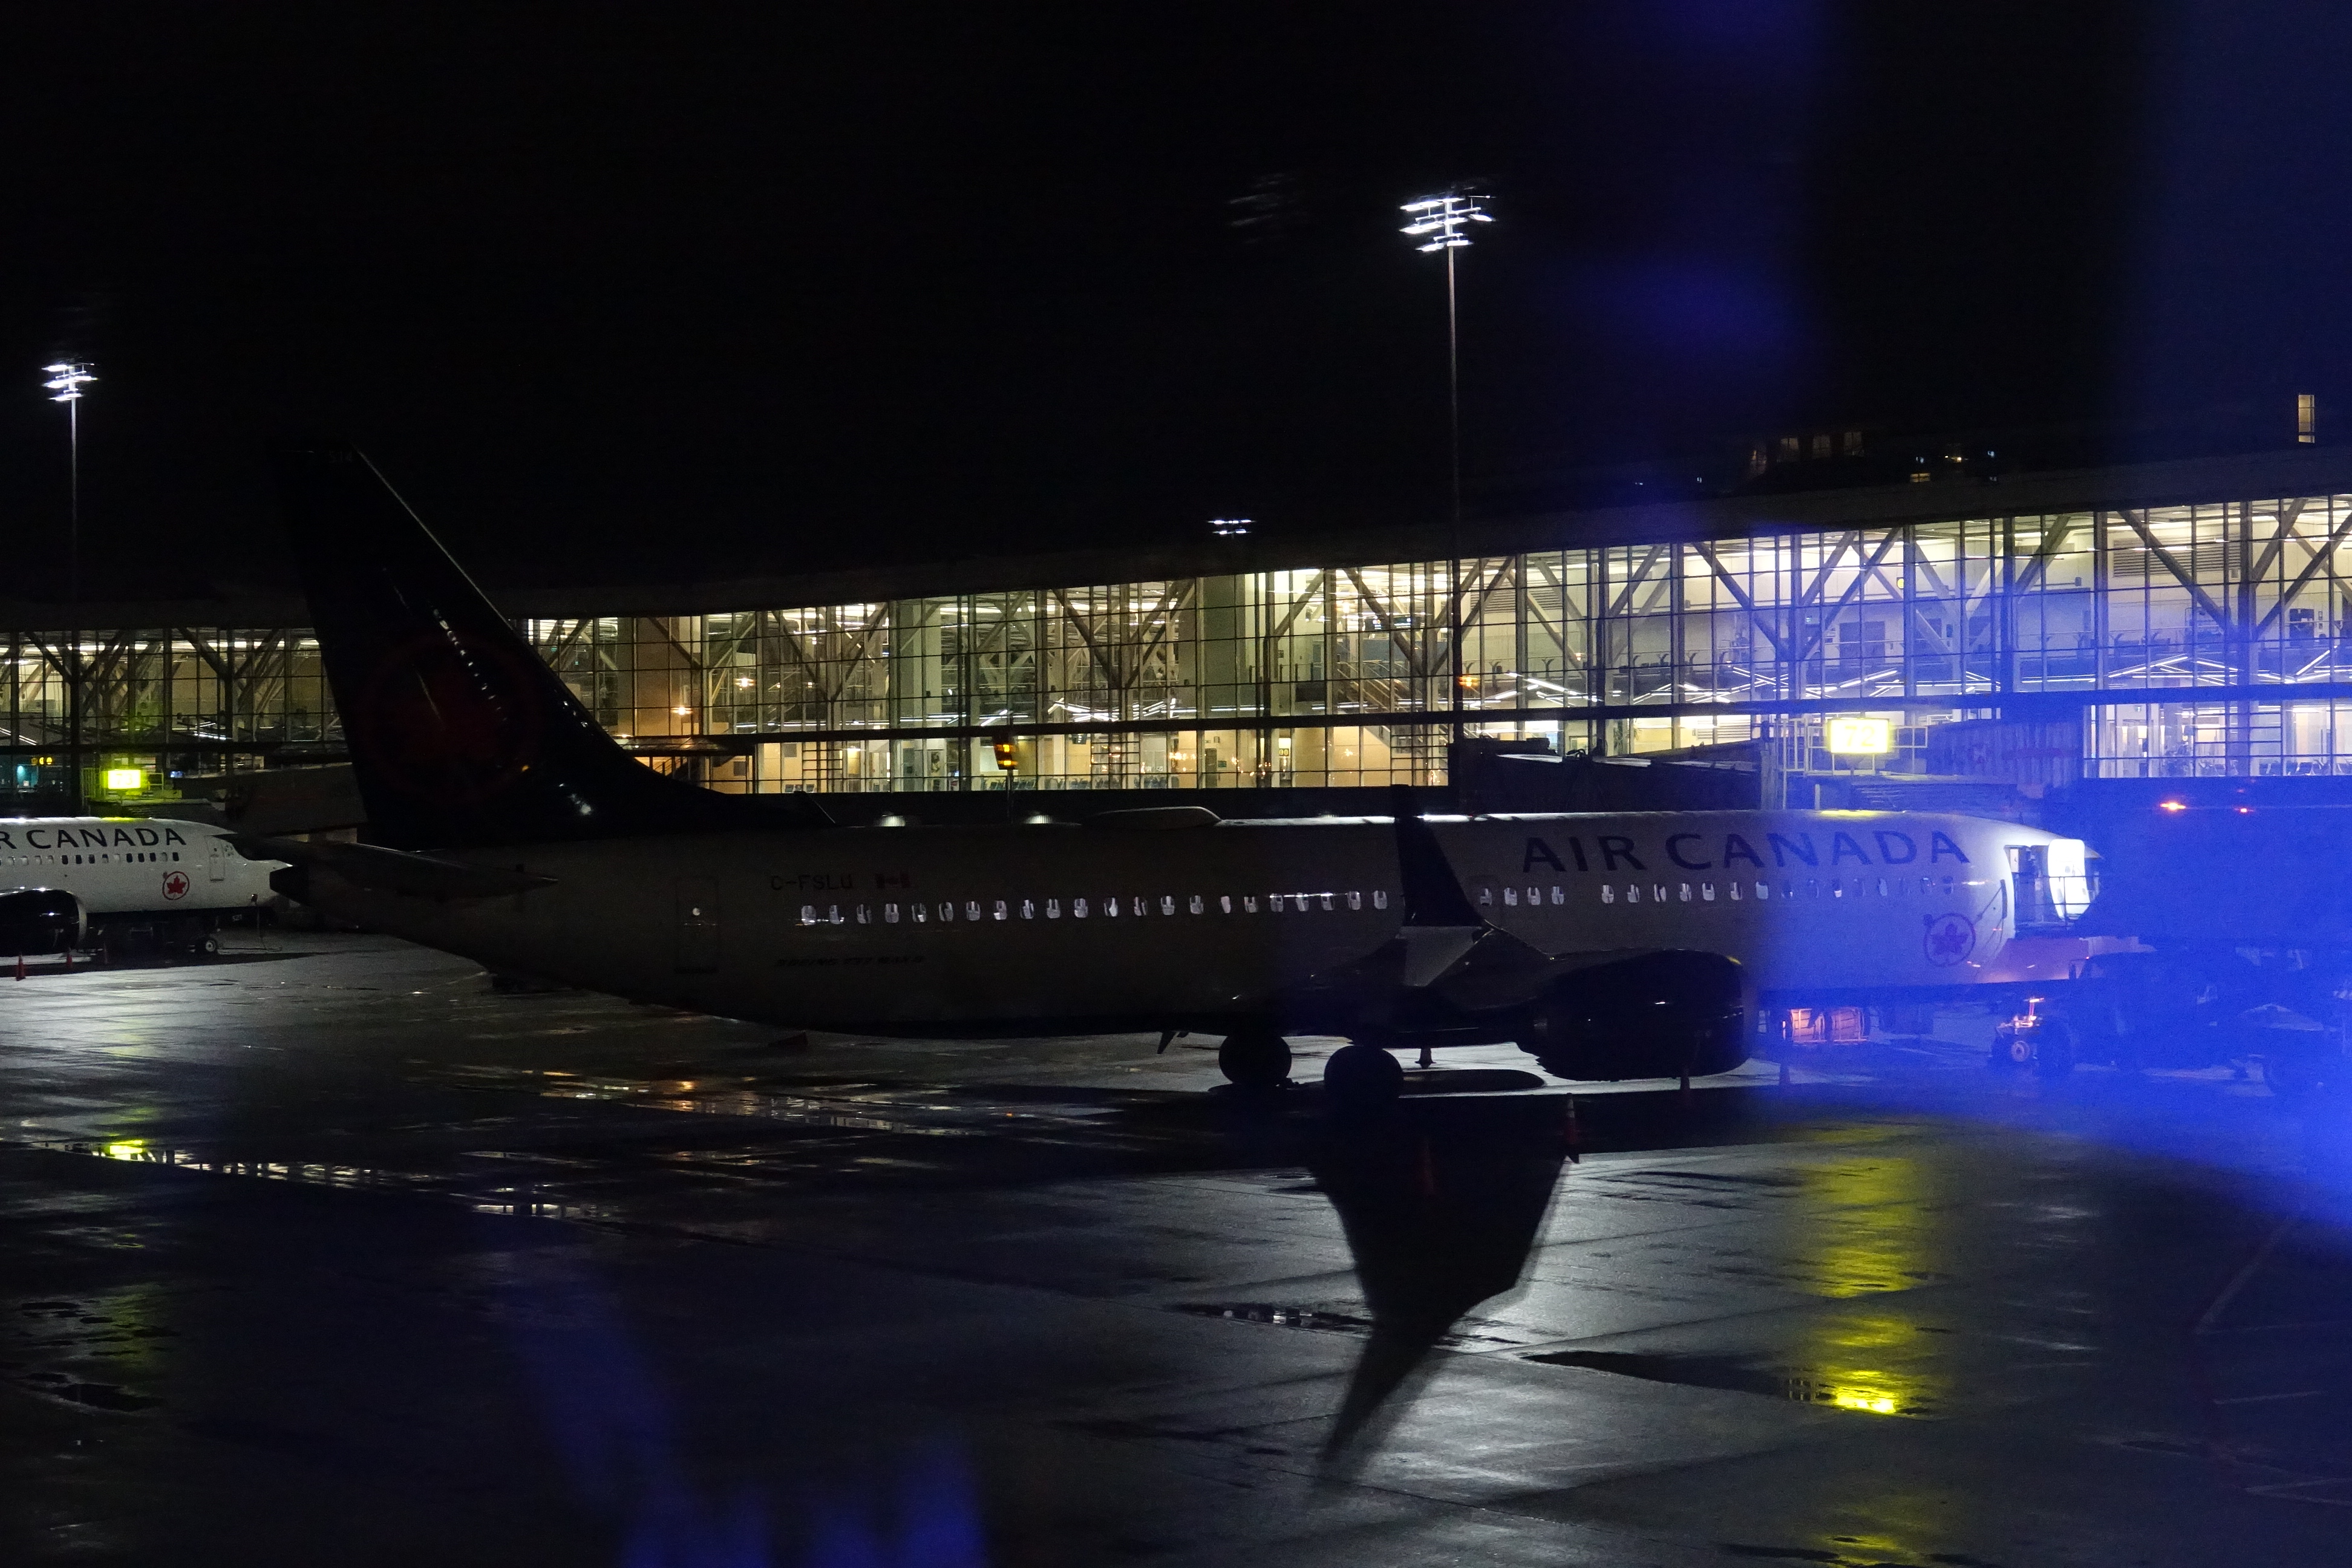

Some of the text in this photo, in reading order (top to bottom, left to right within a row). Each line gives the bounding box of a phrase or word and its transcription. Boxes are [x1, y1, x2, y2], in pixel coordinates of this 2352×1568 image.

[1844, 725, 1875, 746] 72
[26, 828, 186, 849] CANADA
[1522, 831, 1970, 872] AIR CANADA
[771, 874, 854, 890] C-FSLU
